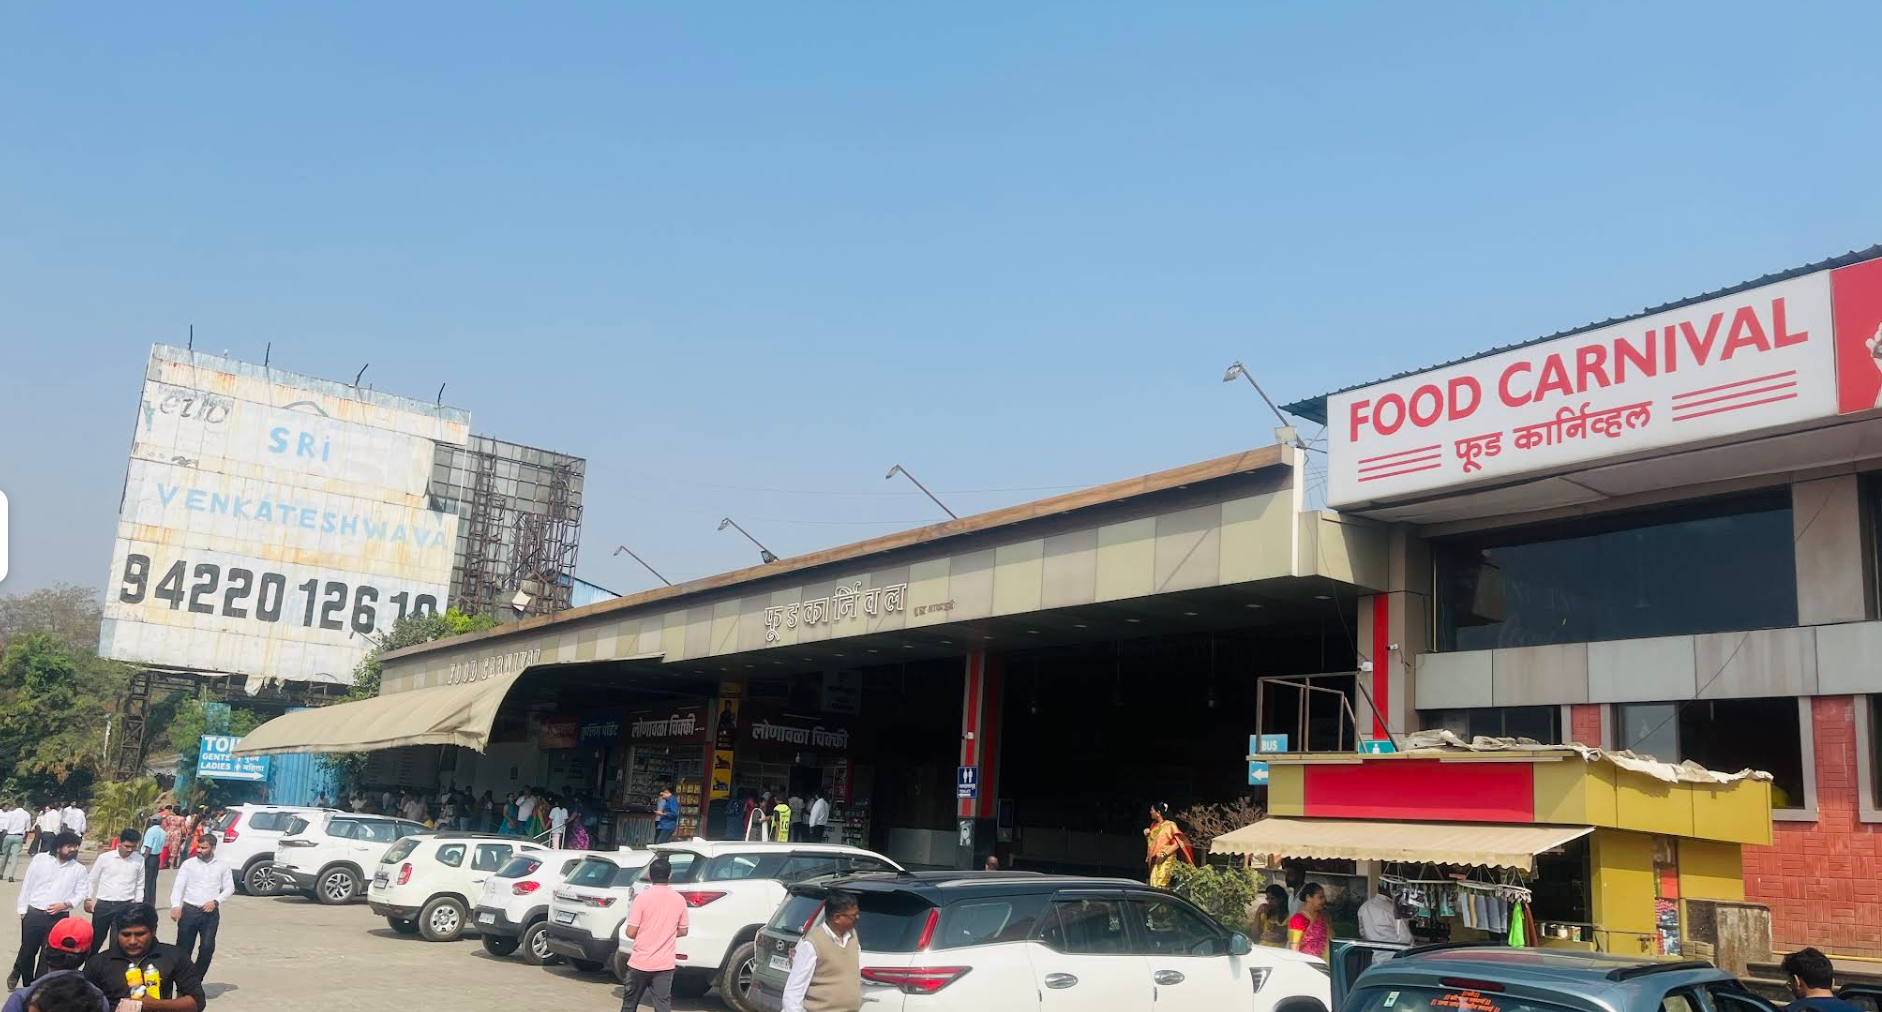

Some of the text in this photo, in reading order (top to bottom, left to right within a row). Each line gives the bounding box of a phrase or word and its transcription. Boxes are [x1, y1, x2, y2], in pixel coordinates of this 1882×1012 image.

[1349, 297, 1808, 442] FOOD CARNIVAL
[1454, 431, 1502, 473] फूड
[119, 553, 287, 623] 94220
[298, 578, 380, 635] 126
[447, 661, 477, 685] FOOD
[1261, 740, 1278, 751] BUS
[200, 762, 231, 770] LADIES
